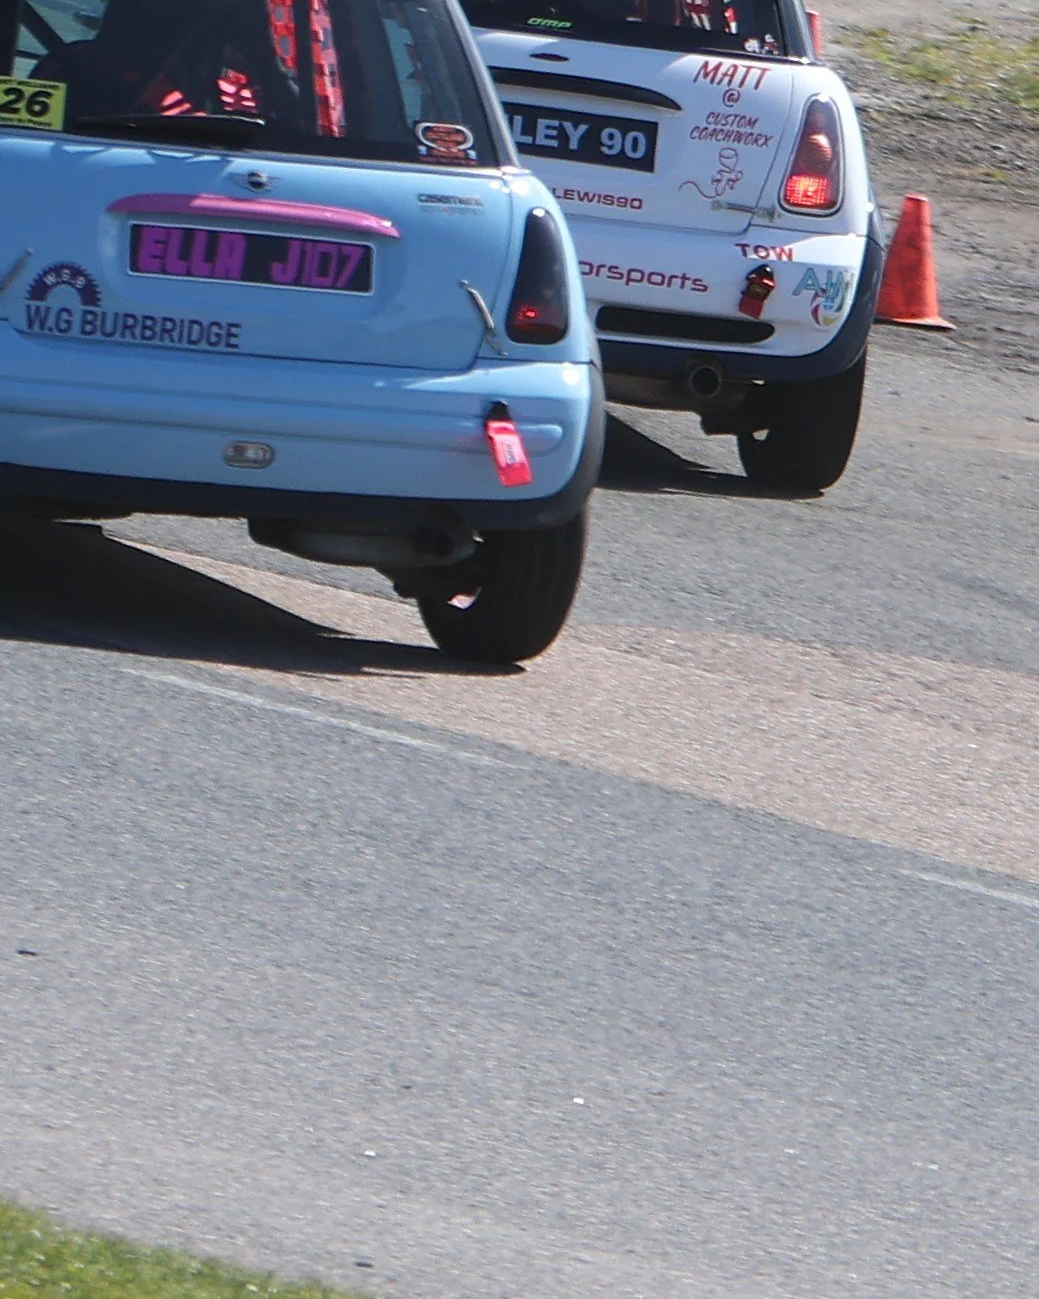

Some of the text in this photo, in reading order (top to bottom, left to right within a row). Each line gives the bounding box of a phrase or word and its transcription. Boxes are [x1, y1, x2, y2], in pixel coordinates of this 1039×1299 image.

[692, 59, 773, 92] MATT
[722, 87, 741, 108] @
[706, 111, 760, 129] CUSTOM
[600, 127, 647, 159] 90
[689, 125, 774, 148] COACHWORX
[136, 225, 248, 281] ELLA
[734, 243, 794, 262] TOW
[579, 260, 709, 293] orsports
[25, 303, 242, 350] W.G BURBRIDGE
